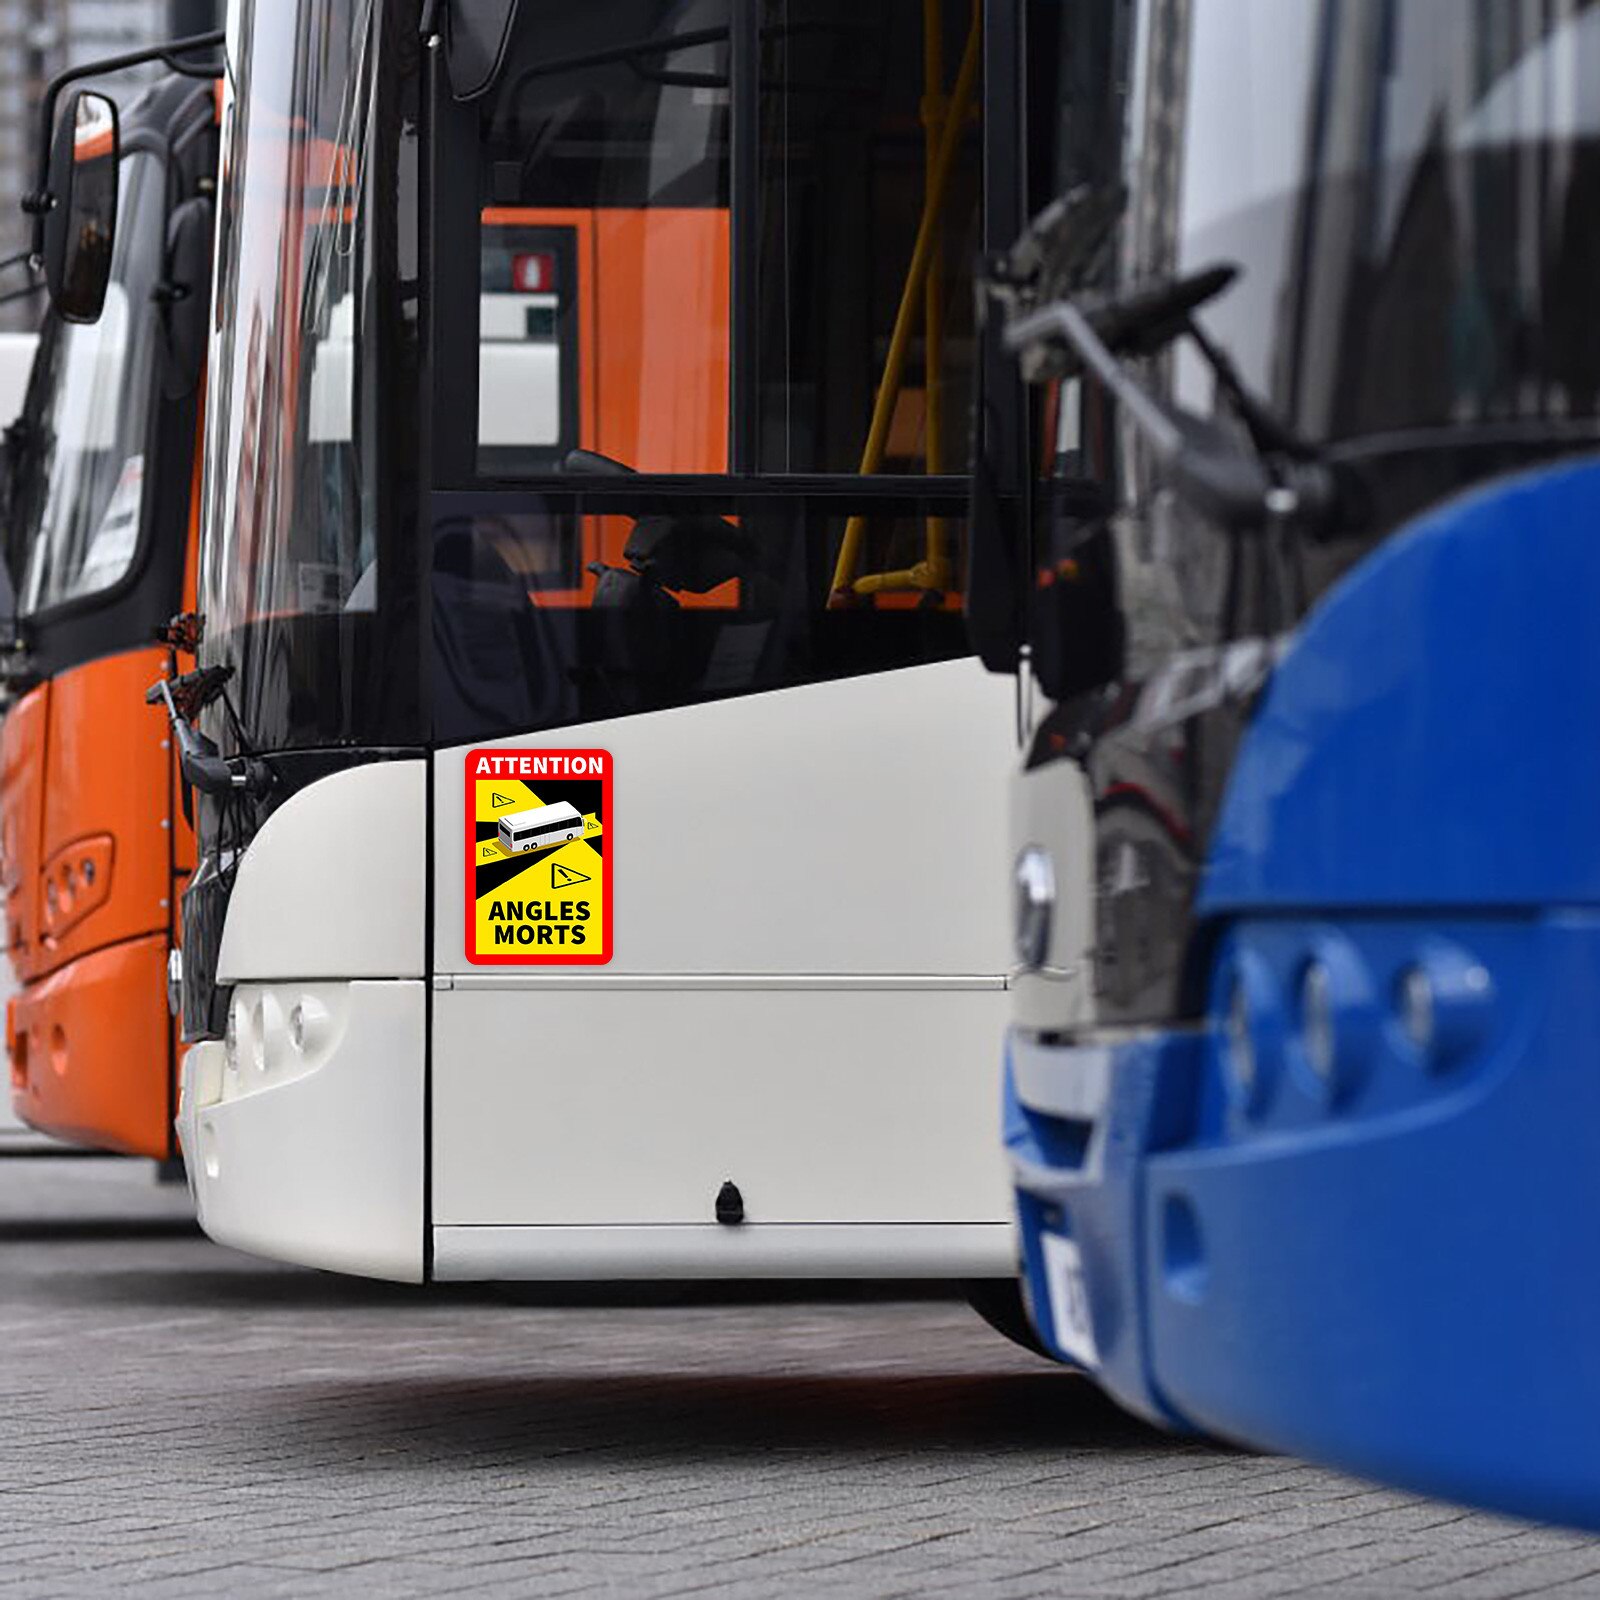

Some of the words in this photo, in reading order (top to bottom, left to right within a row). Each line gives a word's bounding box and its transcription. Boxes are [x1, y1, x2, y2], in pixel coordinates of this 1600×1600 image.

[475, 756, 603, 774] ATTENTION
[488, 901, 591, 921] ANGLES
[494, 924, 587, 945] MORTS
